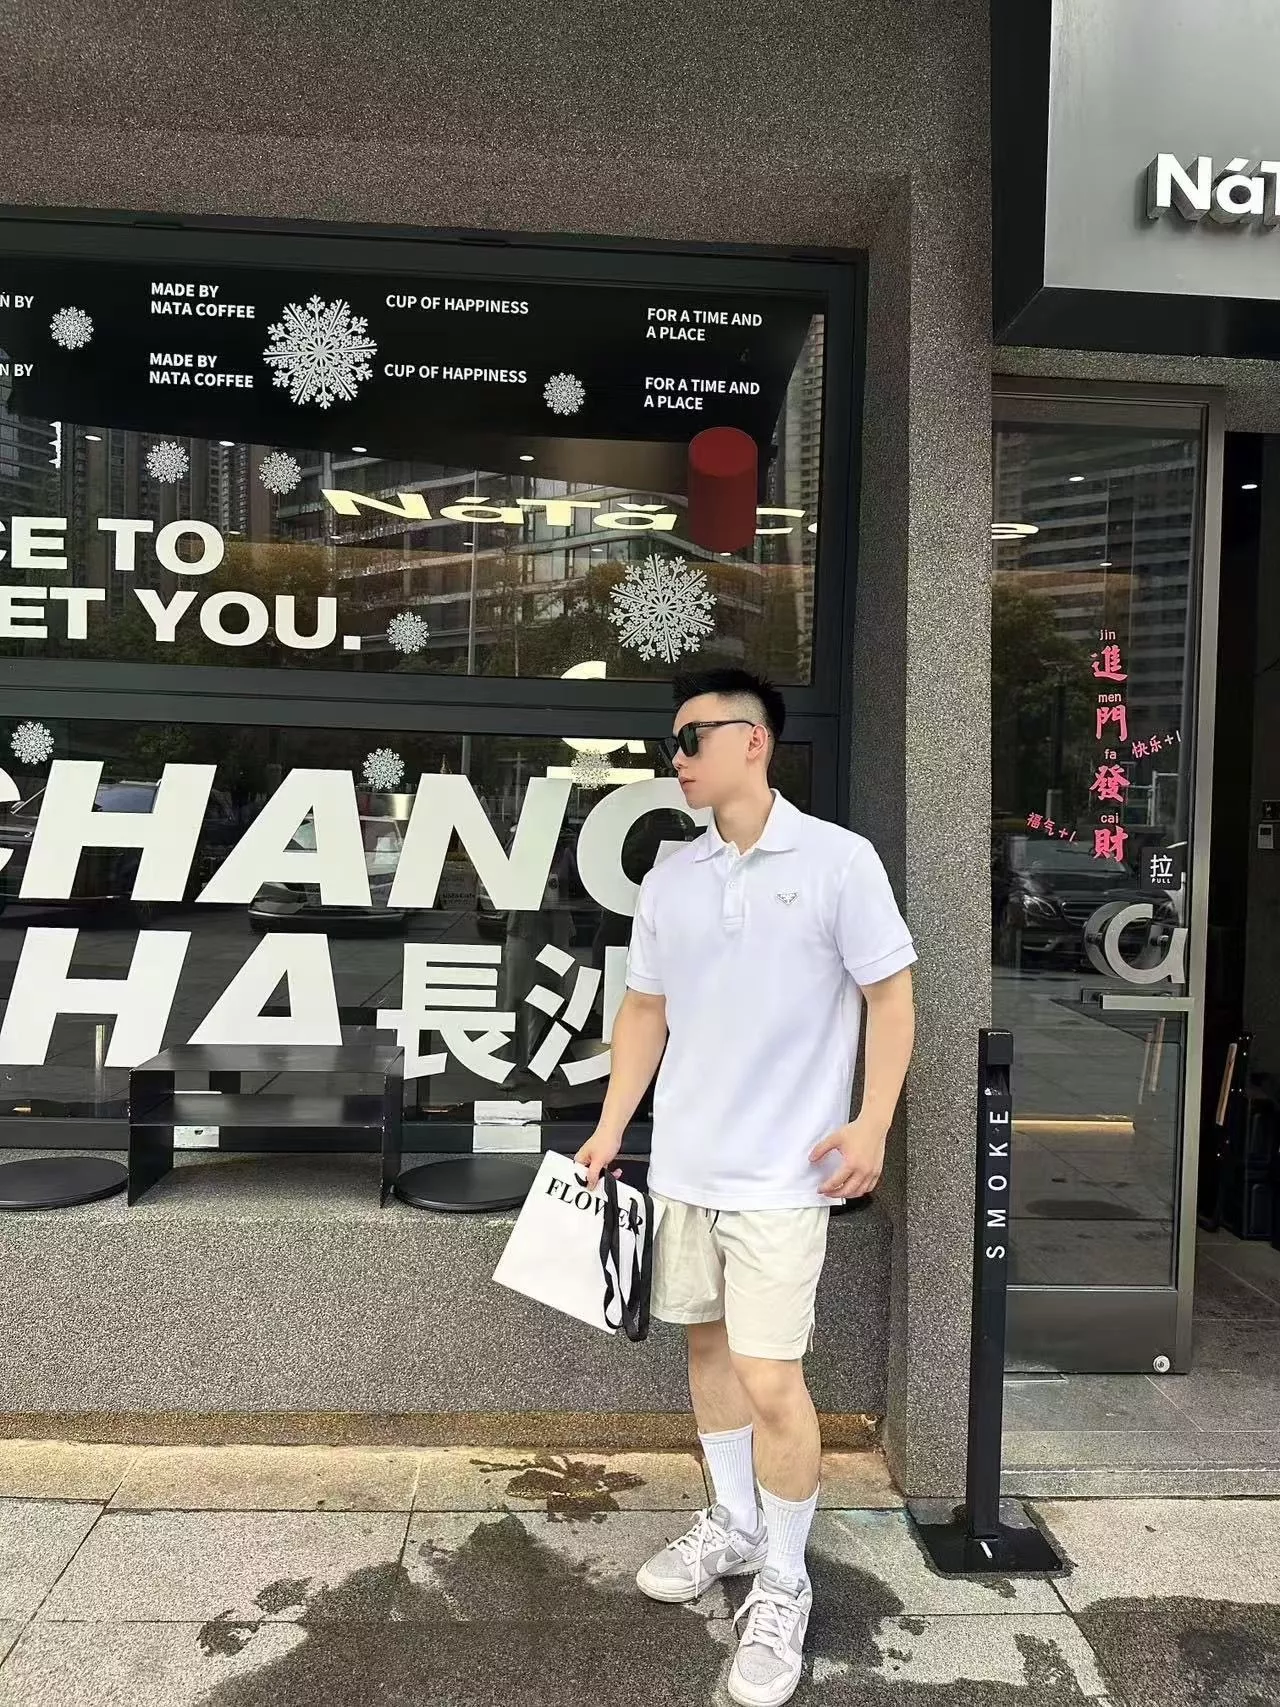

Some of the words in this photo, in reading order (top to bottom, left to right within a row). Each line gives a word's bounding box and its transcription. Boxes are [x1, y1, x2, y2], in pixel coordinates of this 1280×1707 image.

[151, 282, 195, 297] MADE
[199, 284, 219, 298] BY
[15, 295, 34, 308] BY
[151, 301, 193, 316] NATA
[195, 304, 255, 319] COFFEE
[386, 294, 418, 309] CUP
[420, 296, 441, 310] OF
[444, 298, 529, 315] HAPPINESS
[647, 307, 678, 322] FOR
[680, 309, 691, 322] A
[692, 310, 729, 325] TIME
[731, 312, 763, 327] AND
[645, 326, 657, 339] A
[659, 327, 706, 342] PLACE
[14, 363, 34, 377] BY
[149, 353, 194, 367] MADE
[197, 355, 218, 369] BY
[149, 370, 191, 385] NATA
[194, 373, 254, 389] COFFEE
[384, 363, 416, 378] CUP
[418, 365, 439, 379] OF
[442, 367, 528, 384] HAPPINESS
[645, 376, 675, 391] FOR
[677, 378, 688, 392] A
[690, 379, 727, 394] TIME
[728, 381, 760, 396] AND
[643, 395, 655, 408] A
[657, 396, 704, 411] PLACE
[98, 518, 225, 575] TO
[134, 589, 361, 650] YOU.
[1099, 629, 1116, 640] jin
[1098, 693, 1122, 703] men
[1104, 748, 1117, 760] fa
[1100, 813, 1119, 824] cai
[0, 759, 707, 918] HANG
[1150, 854, 1174, 878] 拉
[985, 1110, 1009, 1259] SMOKE
